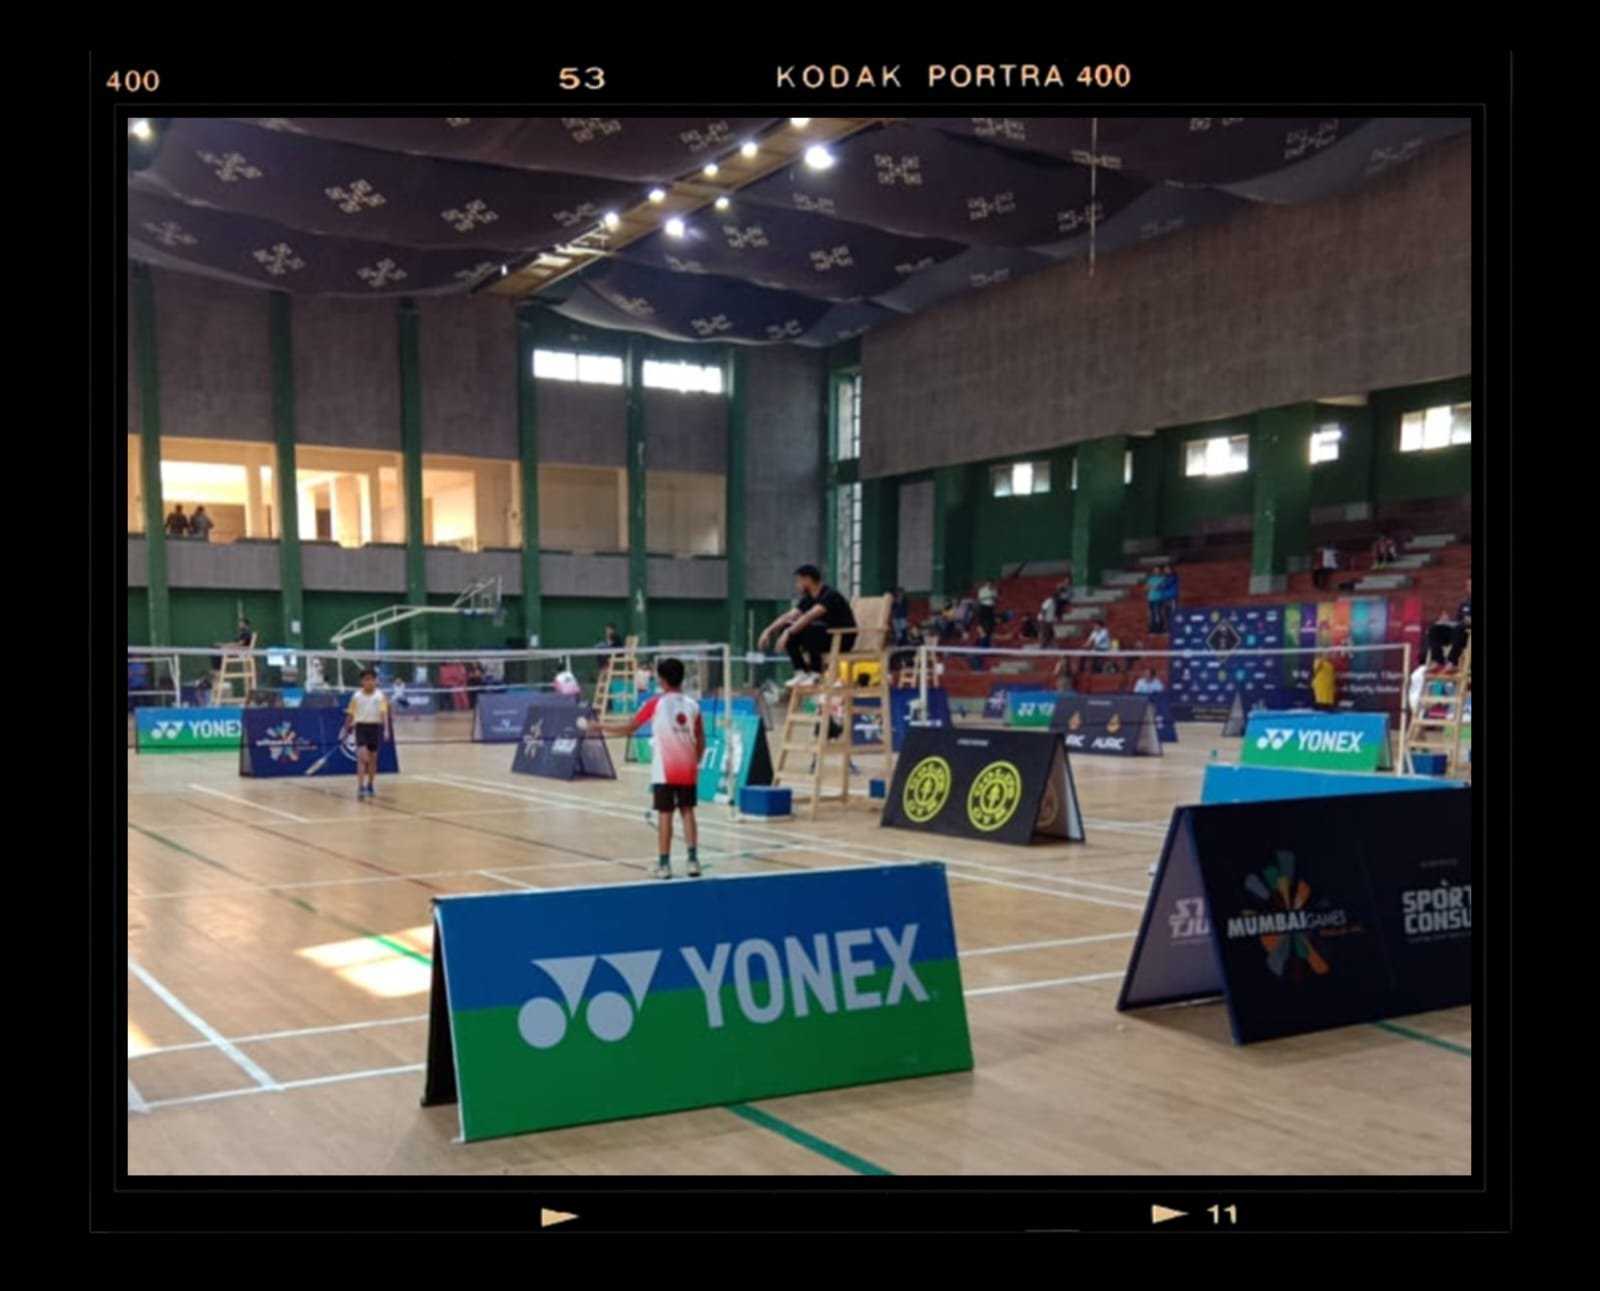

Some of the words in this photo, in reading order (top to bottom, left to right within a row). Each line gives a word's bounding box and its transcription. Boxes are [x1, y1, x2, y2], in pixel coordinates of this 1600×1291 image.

[1297, 729, 1365, 753] YONEX
[1227, 911, 1306, 939] MUMBAI
[1306, 908, 1348, 929] GAMES
[680, 923, 931, 1029] YONEX
